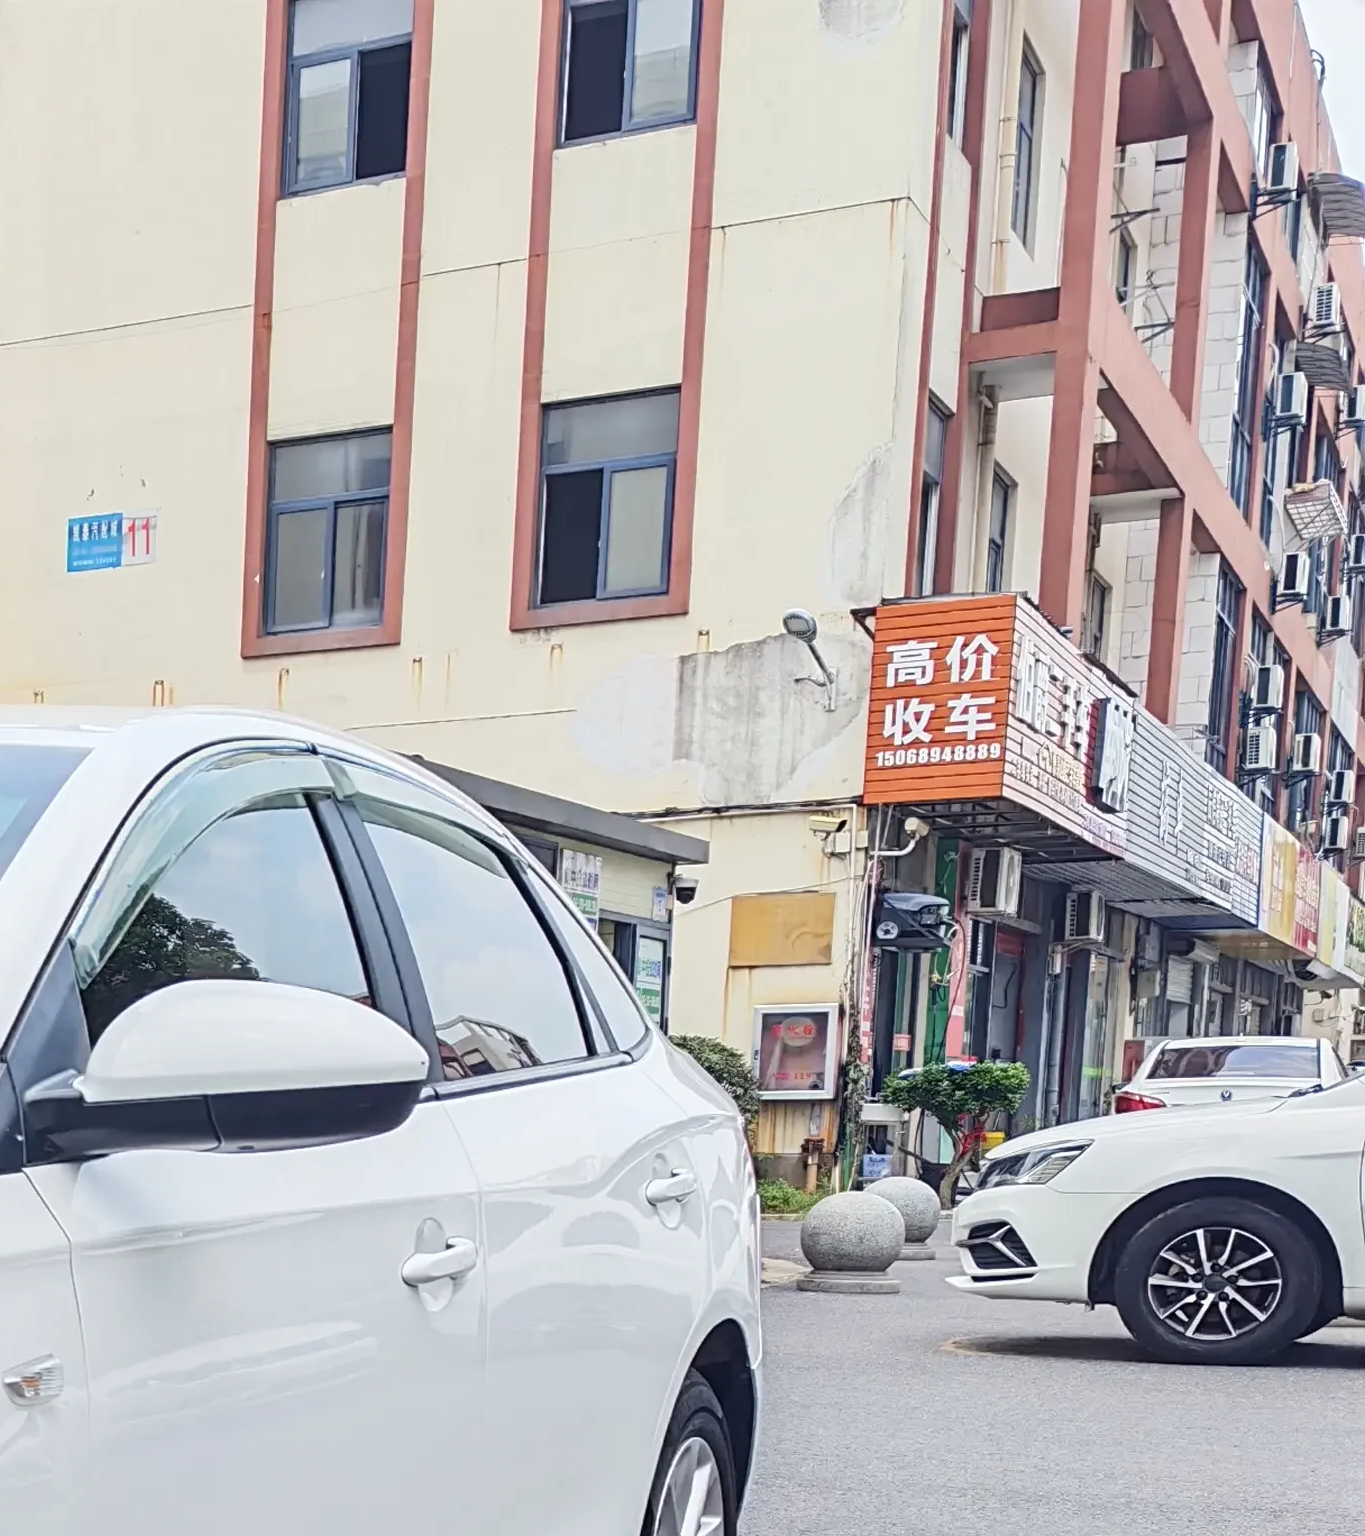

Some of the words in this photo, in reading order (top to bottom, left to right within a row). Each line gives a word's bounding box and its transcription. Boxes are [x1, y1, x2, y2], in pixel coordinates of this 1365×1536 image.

[127, 516, 150, 557] 11
[885, 633, 1000, 688] 高价
[882, 693, 997, 746] 收车
[875, 742, 1001, 767] 15068948889
